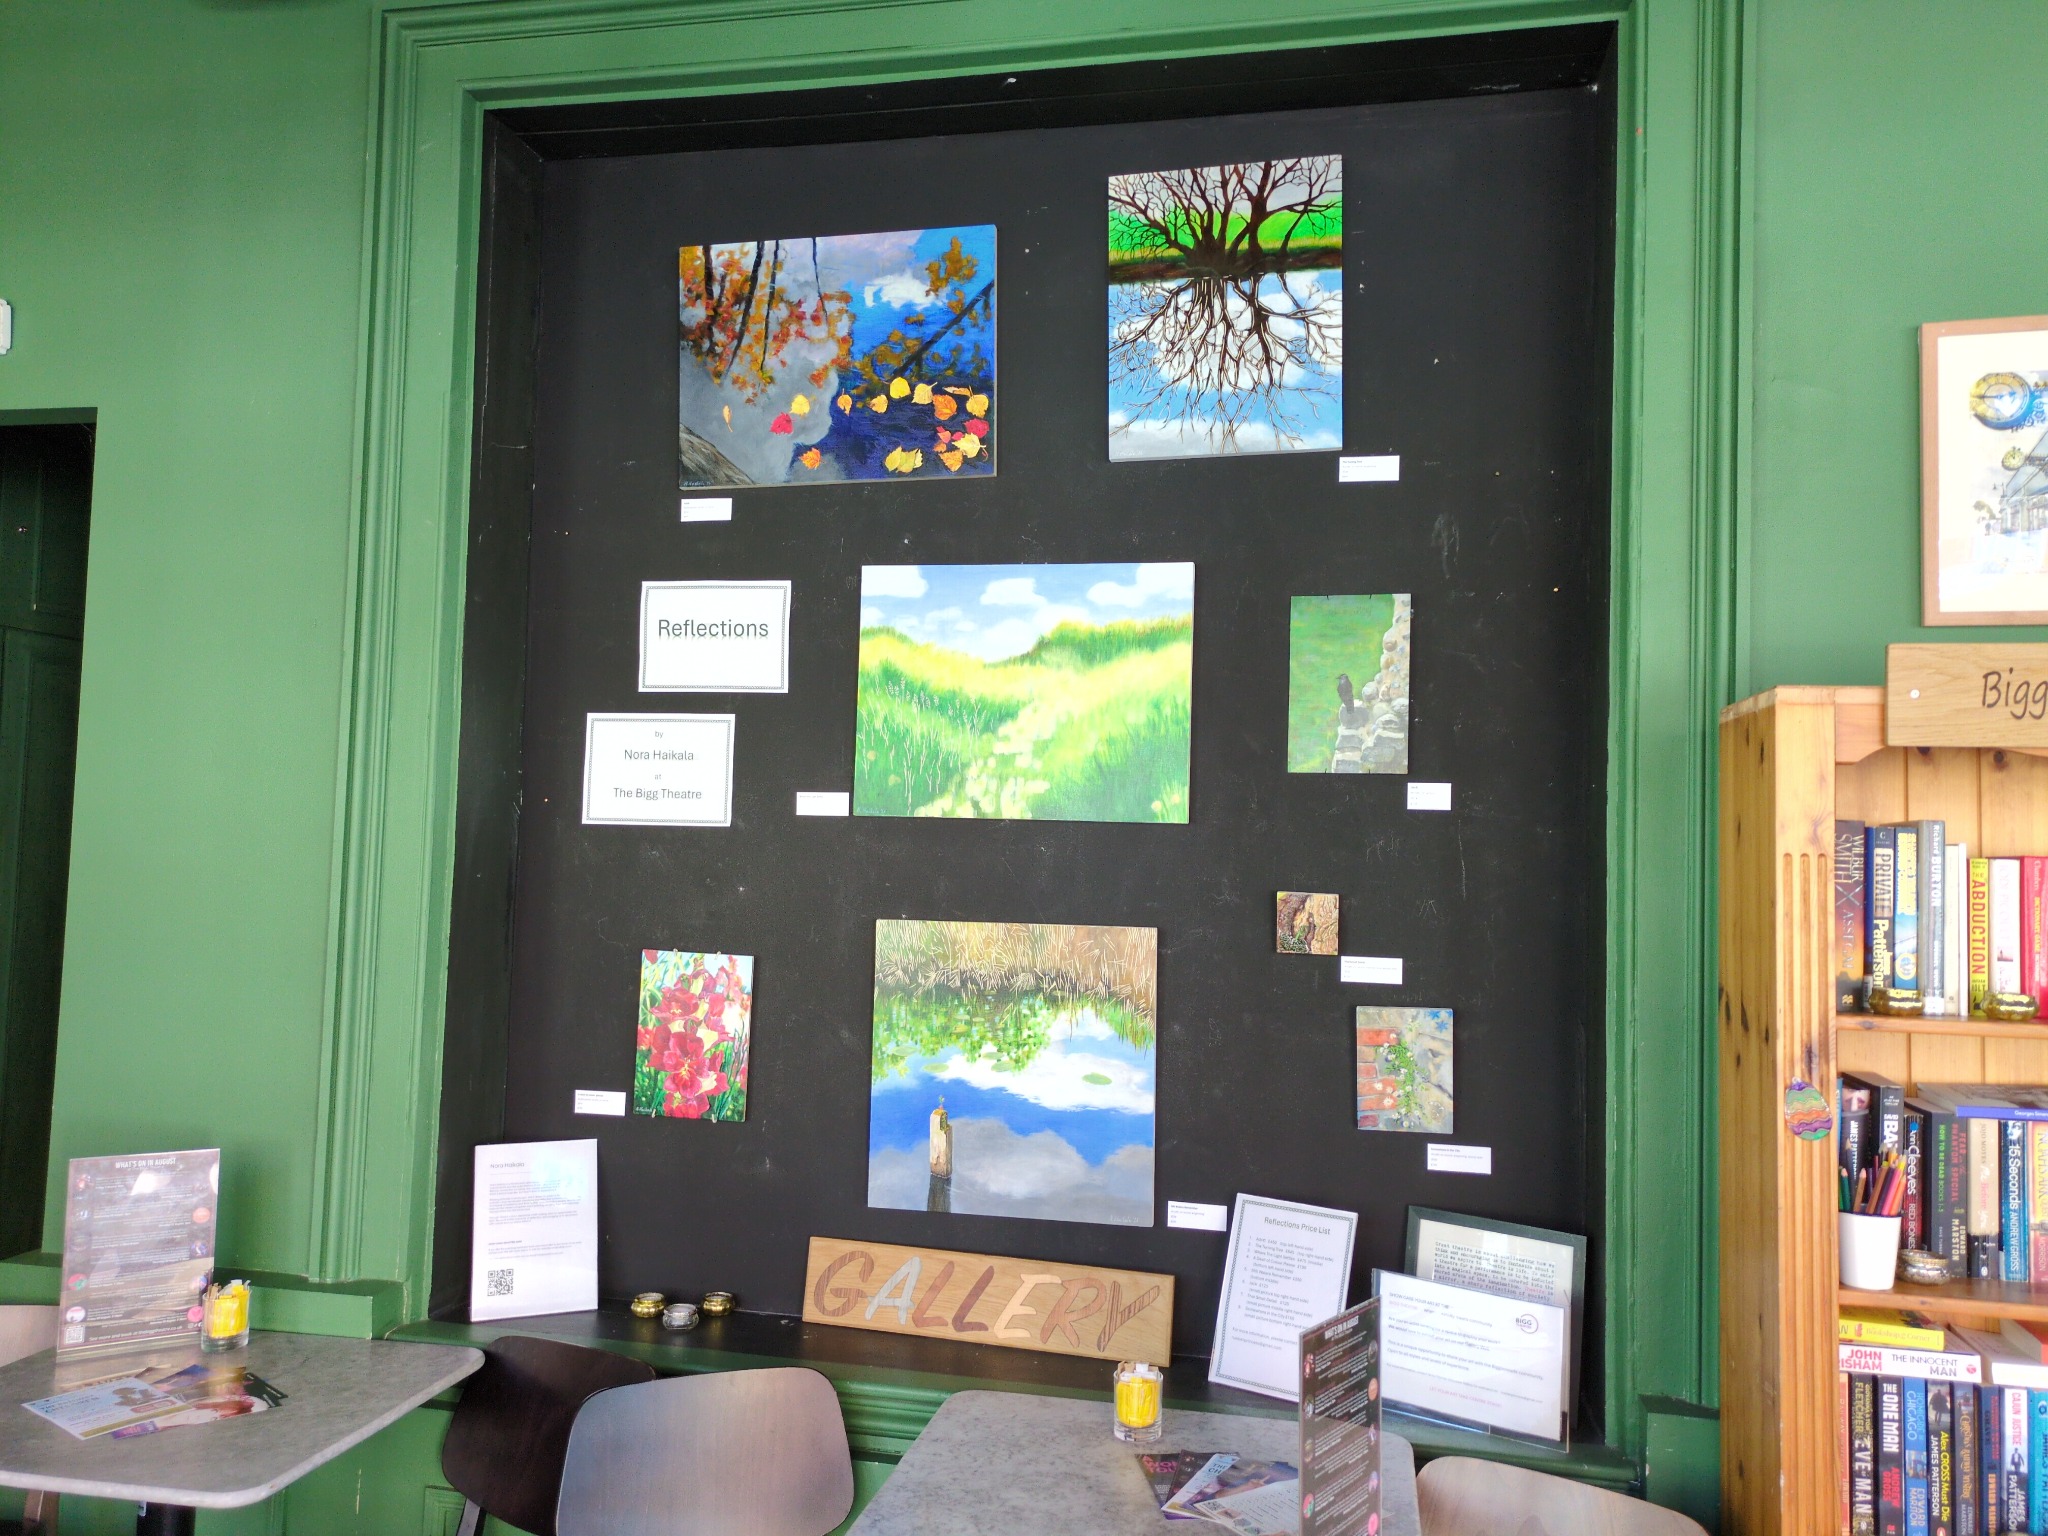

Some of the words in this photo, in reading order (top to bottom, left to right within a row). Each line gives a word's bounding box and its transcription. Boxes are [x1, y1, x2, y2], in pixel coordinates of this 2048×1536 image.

[658, 618, 769, 638] Reflections
[1981, 667, 2048, 720] Bigg
[654, 730, 664, 739] by
[624, 749, 650, 761] Nora
[653, 749, 695, 761] Haikala
[613, 787, 633, 798] The
[635, 787, 658, 801] Bigg
[661, 788, 702, 800] Theatre
[1932, 824, 1941, 854] Richard
[1835, 833, 1852, 884] SMITH
[1851, 834, 1865, 883] WILBUR
[1875, 853, 1891, 915] PRIVATE
[1931, 856, 1942, 907] BURTON
[1971, 879, 1986, 975] ABDUCTION
[1873, 918, 1889, 988] Patterson
[1849, 1120, 1859, 1142] JAMES
[1959, 1132, 1967, 1154] FEAR
[1939, 1142, 1946, 1151] TO
[2008, 1144, 2021, 1157] 15
[115, 1159, 137, 1169] WHAT'S
[147, 1159, 153, 1167] IN
[154, 1158, 176, 1167] AUGUST
[1908, 1145, 1921, 1195] Cleeves
[1951, 1167, 1959, 1202] SPECIAL
[2008, 1158, 2021, 1209] Seconds
[1264, 1217, 1300, 1230] Reflections
[1300, 1223, 1318, 1233] Price
[1318, 1226, 1331, 1235] List
[1908, 1203, 1917, 1220] RED
[1908, 1221, 1916, 1249] BONES
[1951, 1218, 1960, 1261] MARSTON
[2009, 1211, 2020, 1246] ANDREW
[2009, 1246, 2020, 1271] GROSS
[813, 1249, 1162, 1353] GALLERY
[1515, 1317, 1532, 1326] BIGG
[1847, 1349, 1882, 1361] JOHN
[1891, 1353, 1907, 1363] THE
[1909, 1354, 1958, 1366] INNOCENT
[1929, 1366, 1958, 1377] MAN
[1883, 1383, 1897, 1393] THE
[1854, 1382, 1864, 1433] FLETCHER
[1883, 1394, 1899, 1422] ONE
[1906, 1390, 1917, 1441] CHICAGO
[2012, 1392, 2022, 1415] CAJUN
[1882, 1422, 1899, 1453] MAN
[1940, 1431, 1949, 1450] Alex
[2012, 1417, 2022, 1446] JUSTICE
[1931, 1434, 1939, 1464] JAMES
[1940, 1452, 1949, 1481] CROSS
[1855, 1477, 1872, 1514] MAN
[1882, 1470, 1891, 1502] GROSS
[1890, 1466, 1901, 1508] ANDREW
[1932, 1466, 1940, 1516] PATTERSON
[1941, 1482, 1949, 1504] Must
[1988, 1473, 1997, 1504] EDWARD
[1909, 1487, 1918, 1526] MARSTON
[1917, 1487, 1926, 1526] EDWARD
[1942, 1506, 1950, 1522] Die
[2017, 1488, 2026, 1522] JAMES
